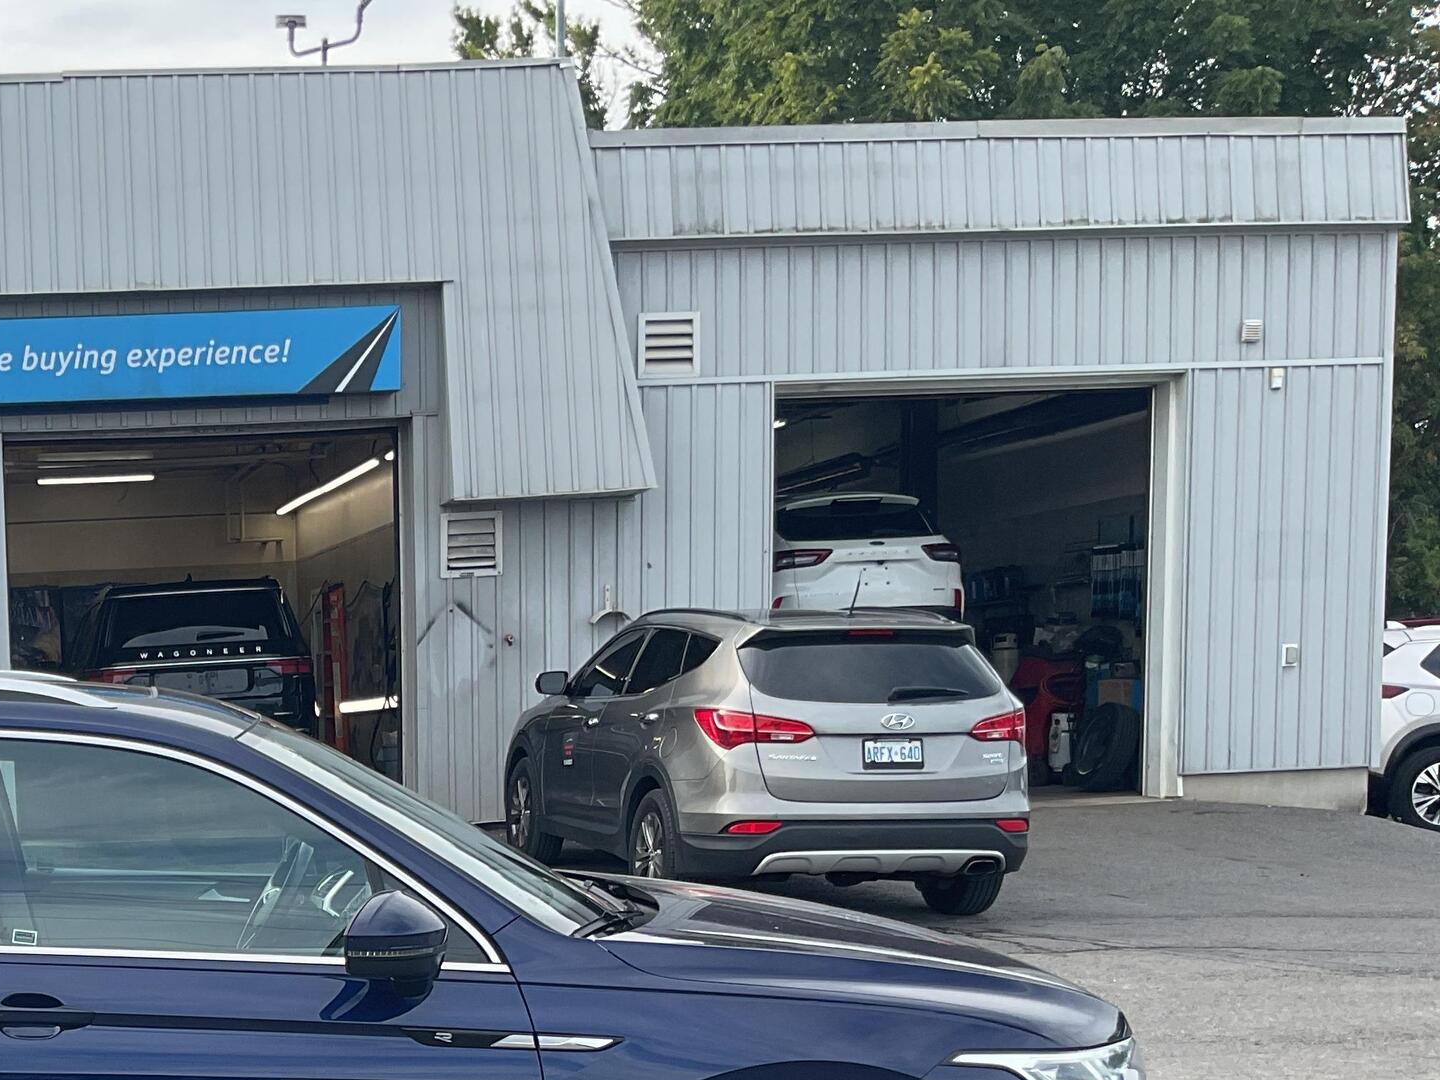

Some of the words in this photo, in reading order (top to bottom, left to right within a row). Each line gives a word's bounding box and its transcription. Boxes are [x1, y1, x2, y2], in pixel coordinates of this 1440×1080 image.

[22, 343, 117, 376] buying
[126, 338, 292, 373] experience!
[140, 646, 262, 659] WAGONEER
[900, 746, 920, 761] 640
